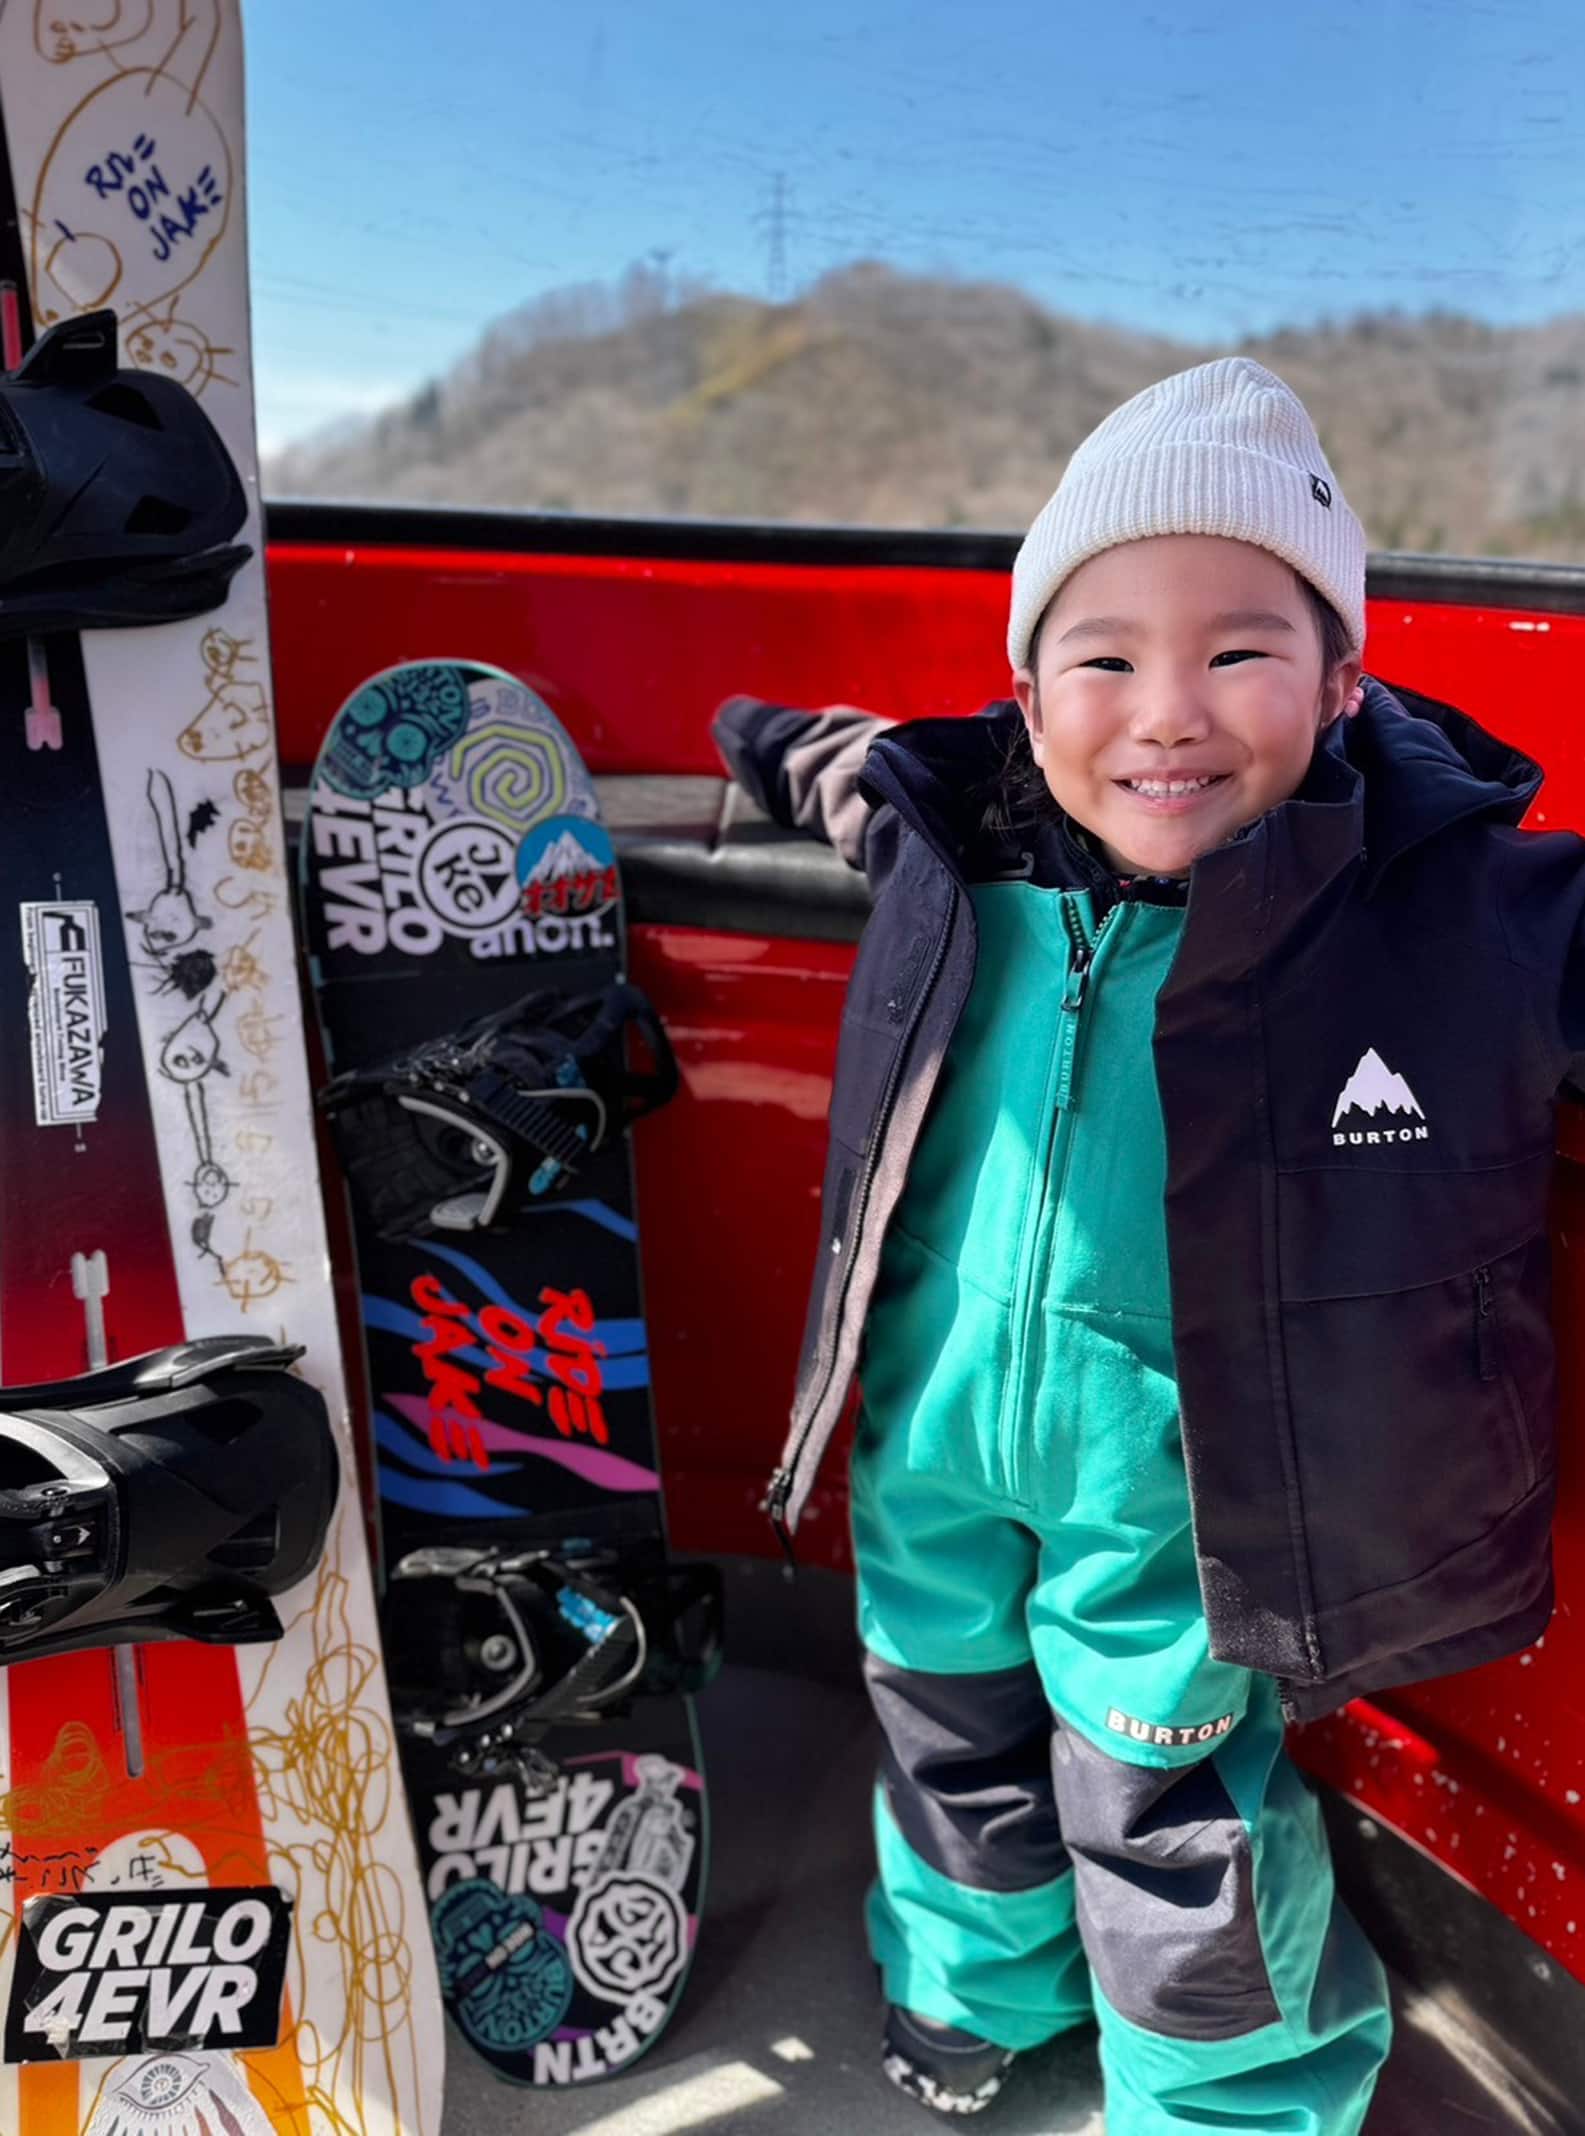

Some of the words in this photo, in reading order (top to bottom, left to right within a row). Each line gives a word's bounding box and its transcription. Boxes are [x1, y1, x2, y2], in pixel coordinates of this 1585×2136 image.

[126, 166, 171, 222] ON
[470, 913, 615, 960] anon.
[63, 957, 95, 1106] FUKAZAWA
[1332, 1126, 1429, 1147] BURTON
[410, 1274, 490, 1472] JAKE
[478, 1305, 543, 1406] ON
[1108, 1709, 1232, 1745] BURTON
[429, 1772, 613, 1854] 4EVR
[36, 1898, 272, 1973] GRILO
[23, 1965, 258, 2043] 4EVR
[535, 1996, 666, 2085] BRTN
